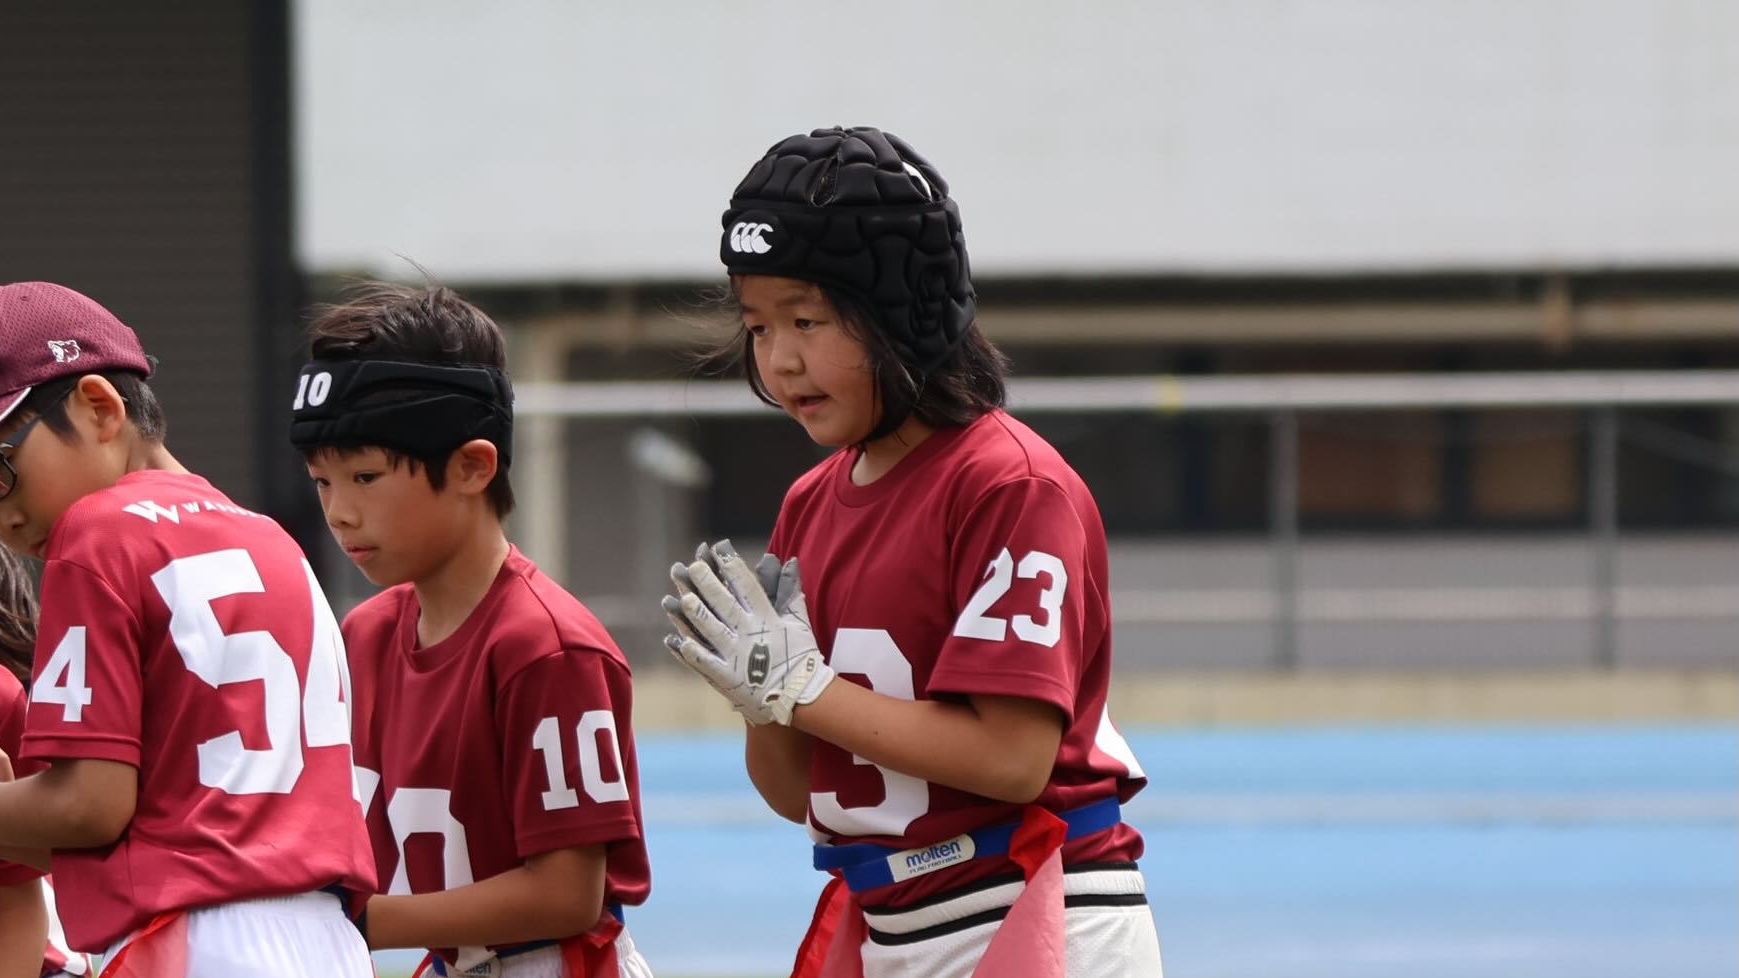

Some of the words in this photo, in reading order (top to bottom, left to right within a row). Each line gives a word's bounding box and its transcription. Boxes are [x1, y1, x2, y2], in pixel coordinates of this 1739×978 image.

[293, 371, 333, 411] 10
[953, 547, 1069, 649] 23
[31, 625, 93, 722] 4
[150, 547, 355, 795] 54
[532, 710, 630, 811] 10
[905, 841, 962, 868] molten
